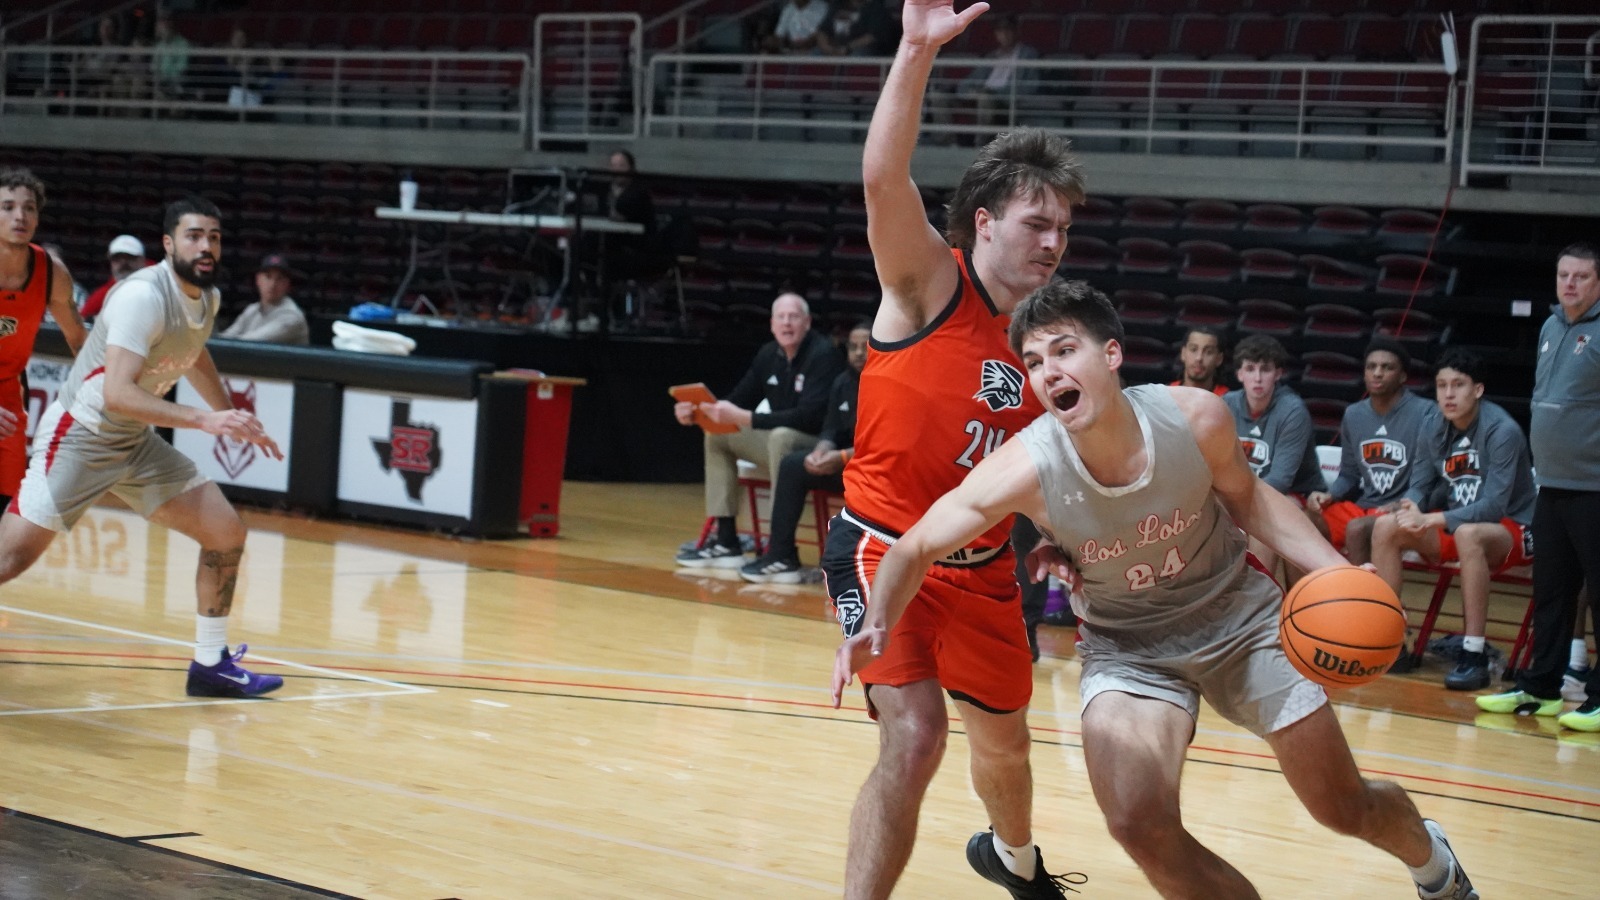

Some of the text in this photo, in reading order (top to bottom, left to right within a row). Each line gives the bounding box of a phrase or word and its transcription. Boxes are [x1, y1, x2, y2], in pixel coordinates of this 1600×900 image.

[392, 436, 431, 463] SR
[1362, 441, 1403, 461] UTPB
[1079, 508, 1202, 564] Los Lobo
[1125, 546, 1187, 591] 24
